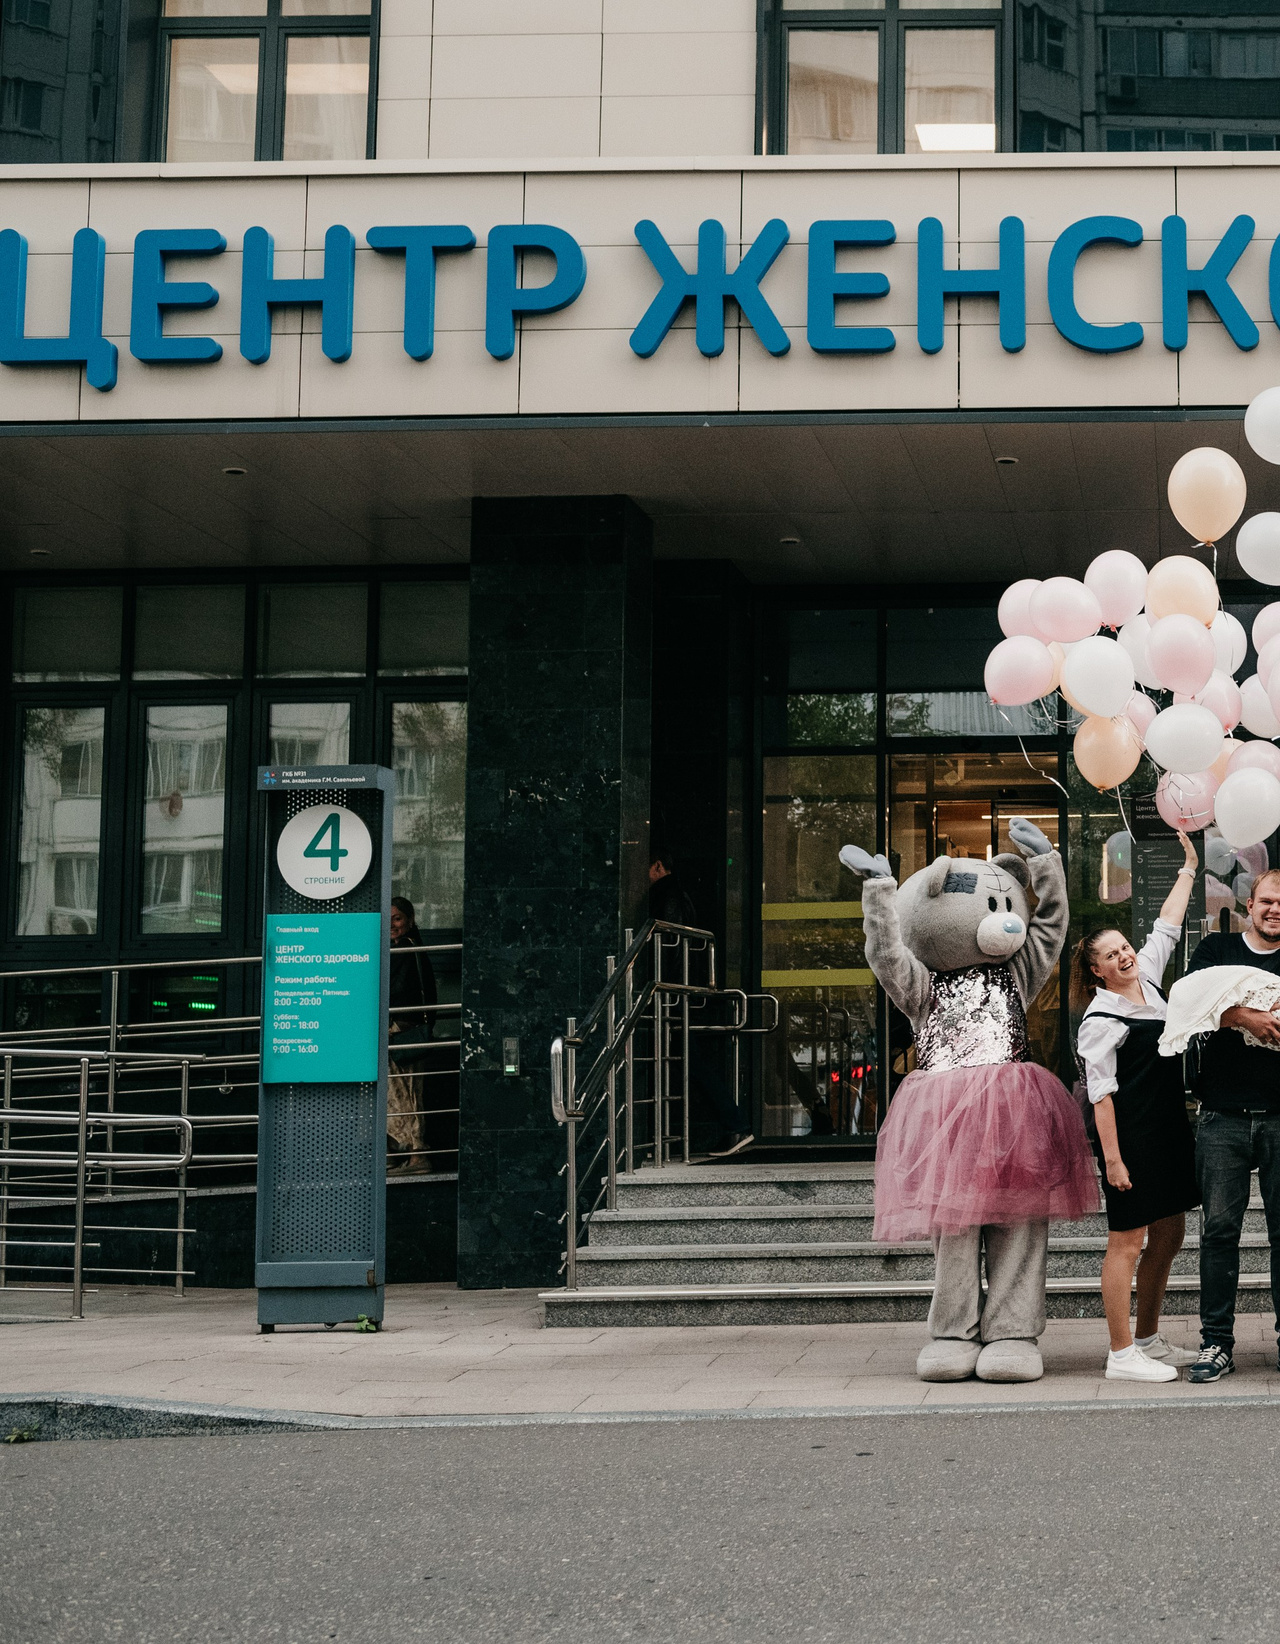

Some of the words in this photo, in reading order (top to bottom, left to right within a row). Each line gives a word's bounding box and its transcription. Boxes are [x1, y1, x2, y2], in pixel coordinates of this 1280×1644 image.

[0, 223, 588, 393] ЦЕНТР
[303, 812, 349, 872] 4
[1136, 854, 1144, 864] 5
[304, 876, 346, 885] СТРОЕНИЕ
[1137, 917, 1145, 927] 2
[275, 945, 305, 954] ЦЕНТР
[275, 955, 322, 963] ЖЕНСКОГО
[323, 954, 370, 964] ЗДОРОВЬЯ
[274, 976, 302, 984] Режим
[304, 975, 338, 986] работы:
[274, 997, 292, 1005] 8:00
[299, 997, 322, 1006] 20:00
[273, 1013, 300, 1021] Суббота:
[273, 1021, 291, 1029] 9:00
[298, 1021, 320, 1029] 18:00
[272, 1045, 290, 1053] 9:00
[298, 1045, 319, 1053] 16:00
